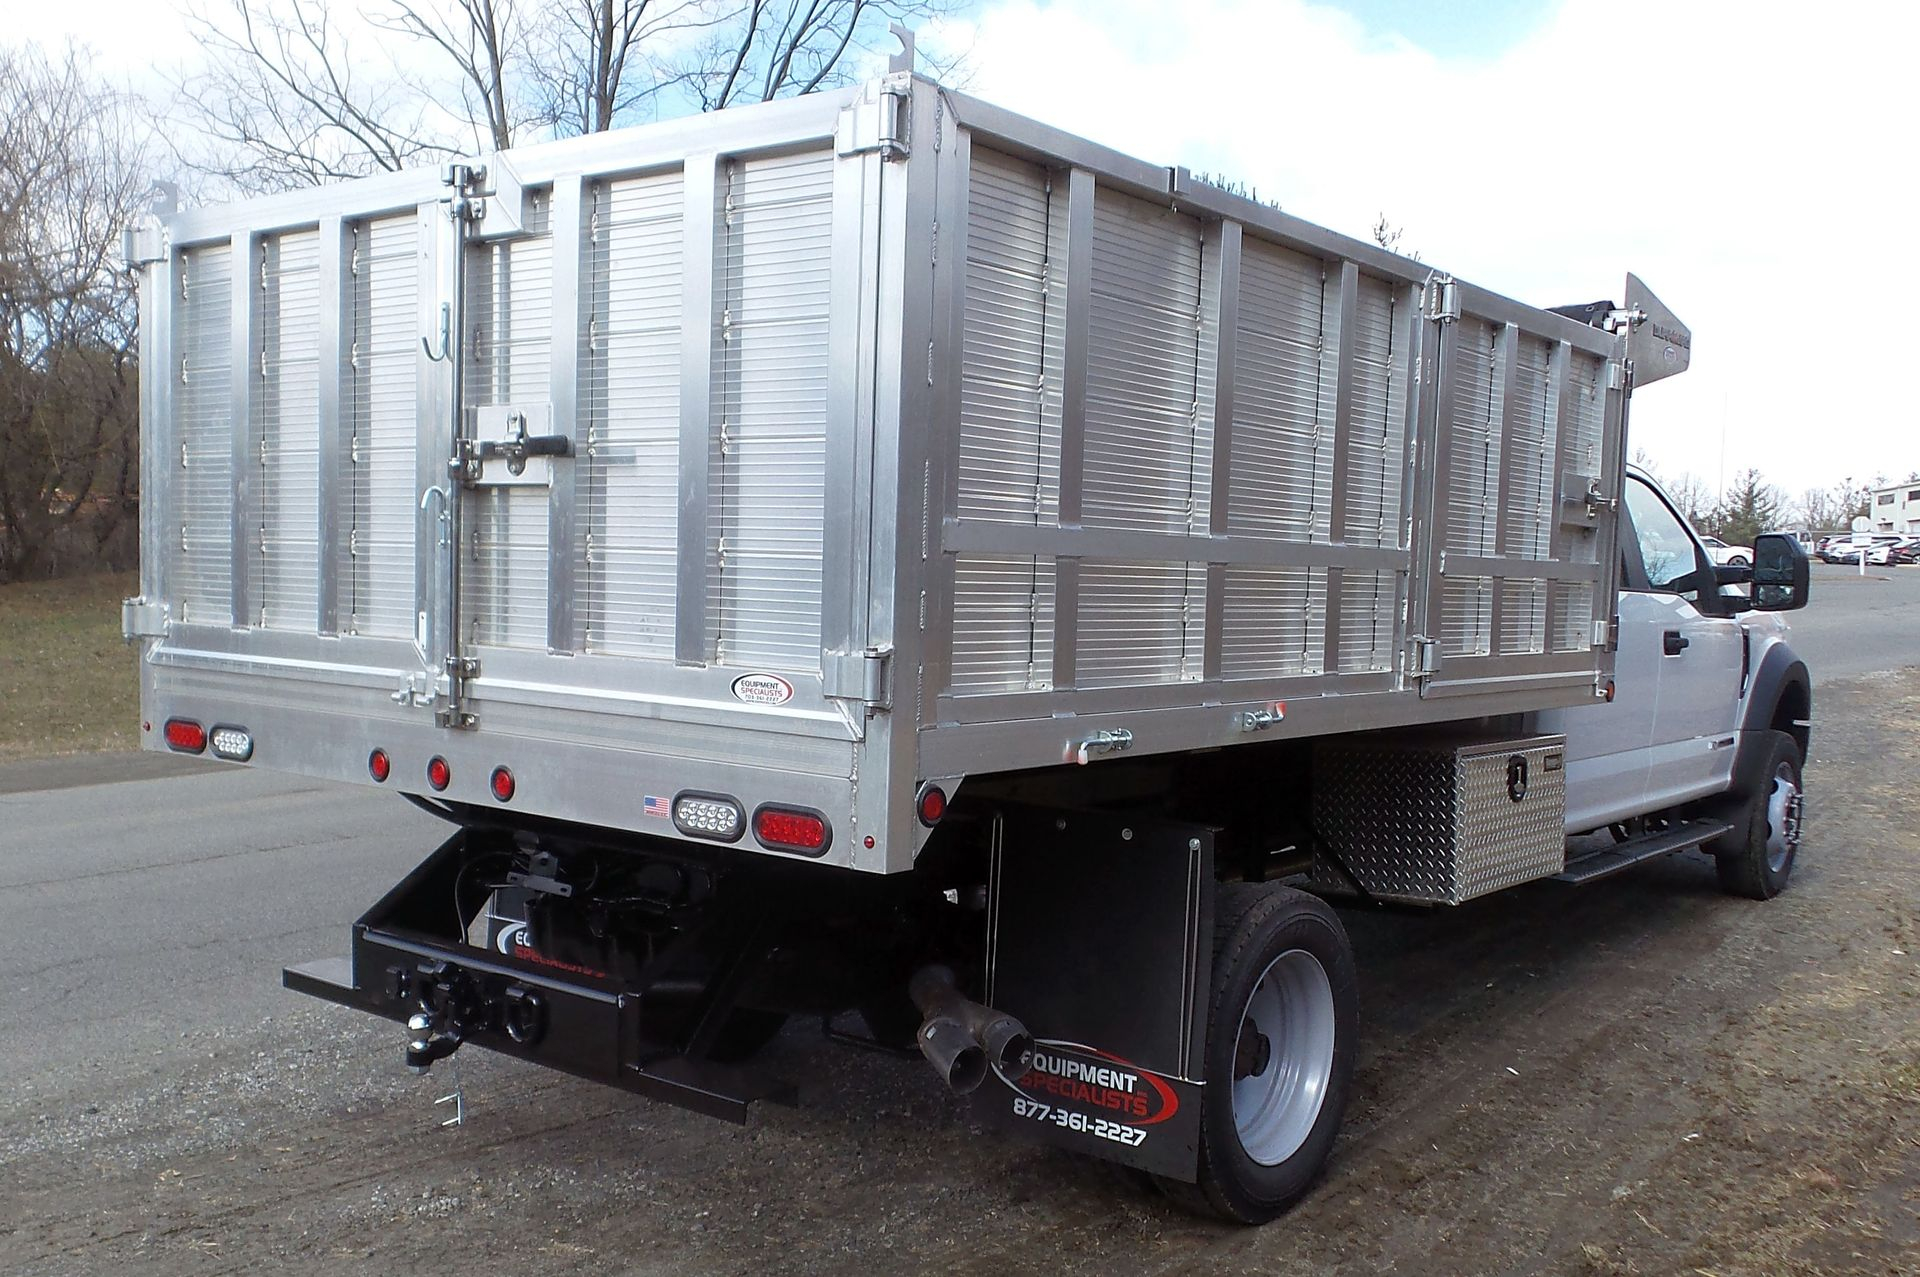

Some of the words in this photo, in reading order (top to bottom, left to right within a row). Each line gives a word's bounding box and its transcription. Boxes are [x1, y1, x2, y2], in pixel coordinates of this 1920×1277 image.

[741, 680, 779, 690] EQUIPMENT
[741, 687, 783, 697] SPECIALISTS
[1019, 1073, 1148, 1117] SPECIALISTS
[1013, 1097, 1147, 1147] 877-361-2227
